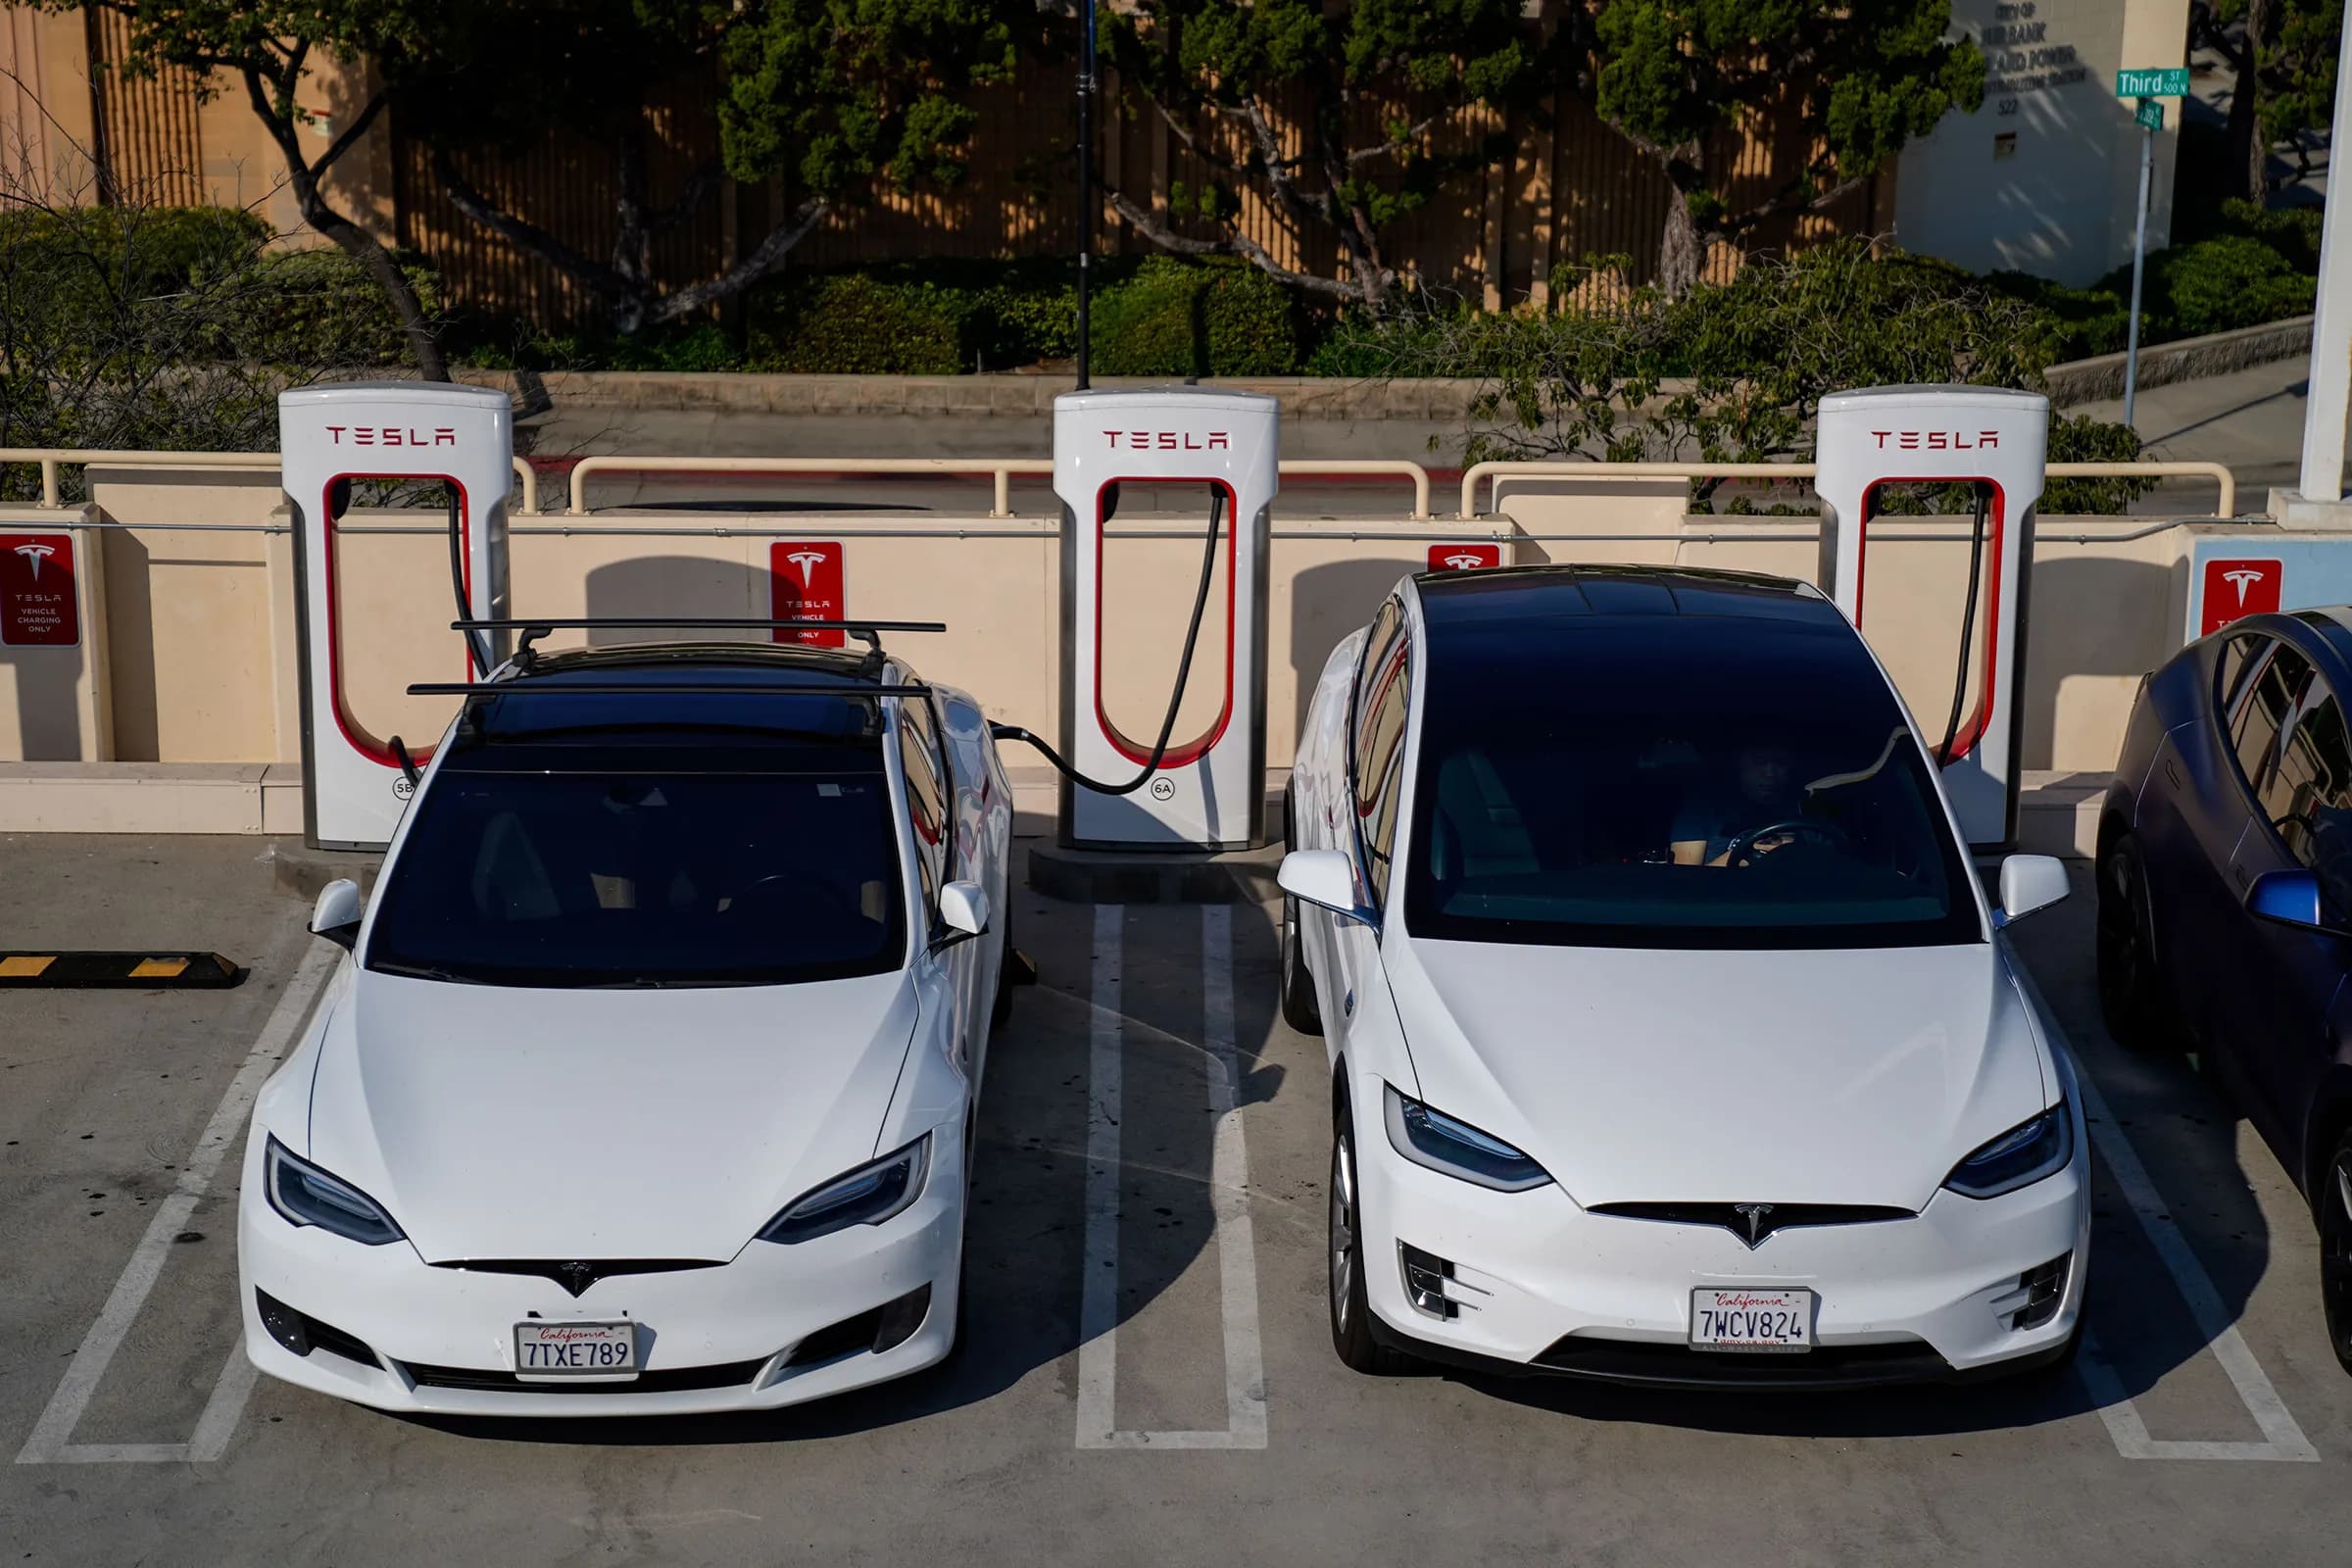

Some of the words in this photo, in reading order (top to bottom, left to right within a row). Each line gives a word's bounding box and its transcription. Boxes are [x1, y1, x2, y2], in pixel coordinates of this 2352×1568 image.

[2120, 73, 2162, 93] Third
[2170, 71, 2180, 81] ST
[2180, 82, 2186, 94] N
[1998, 99, 2018, 116] 522
[325, 426, 455, 446] TESLA
[1102, 431, 1228, 449] TESLA
[1871, 431, 1998, 449] TESLA
[397, 783, 414, 793] 5B
[1154, 784, 1171, 794] 6A
[1716, 1293, 1789, 1309] California
[1699, 1310, 1802, 1338] 7WCV824
[540, 1327, 612, 1343] California
[524, 1342, 628, 1366] 7TXE789
